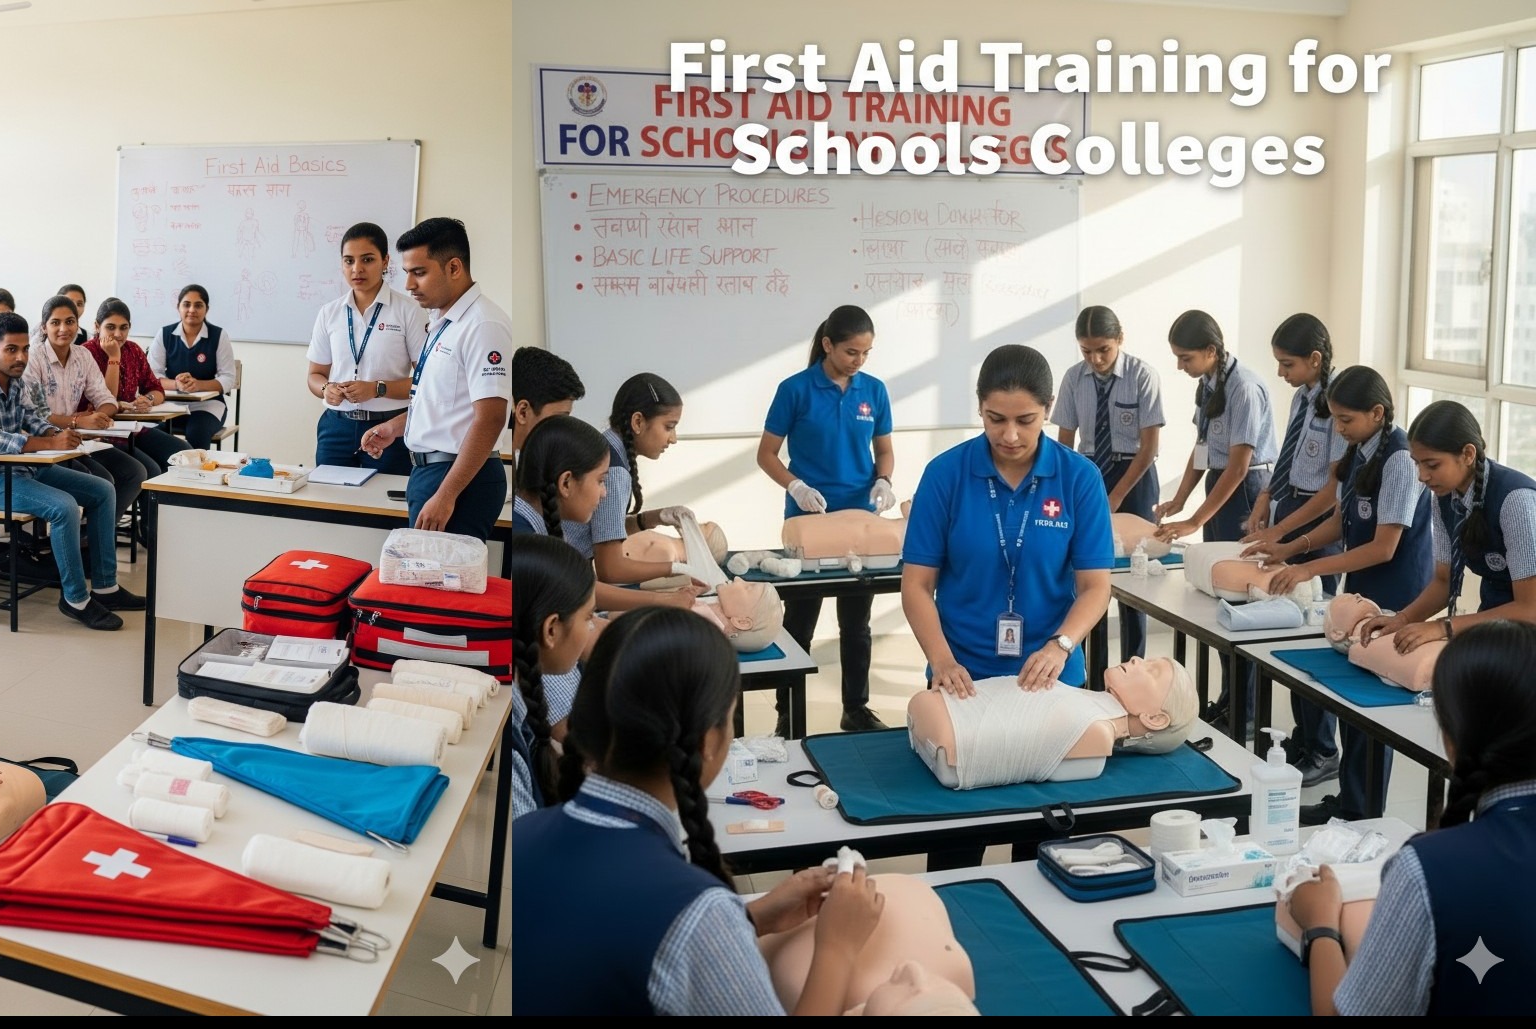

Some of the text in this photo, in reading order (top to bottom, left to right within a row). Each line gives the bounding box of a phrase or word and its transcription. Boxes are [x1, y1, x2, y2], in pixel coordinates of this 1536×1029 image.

[655, 84, 1011, 127] FIRST AID TRAINING
[559, 124, 630, 157] FOR
[640, 125, 809, 160] SCHOLS
[206, 154, 347, 175] First Aid Basics
[588, 183, 830, 207] EMERGENCY PROCEDURES
[593, 245, 779, 267] BASIC LIFE SUPPORT
